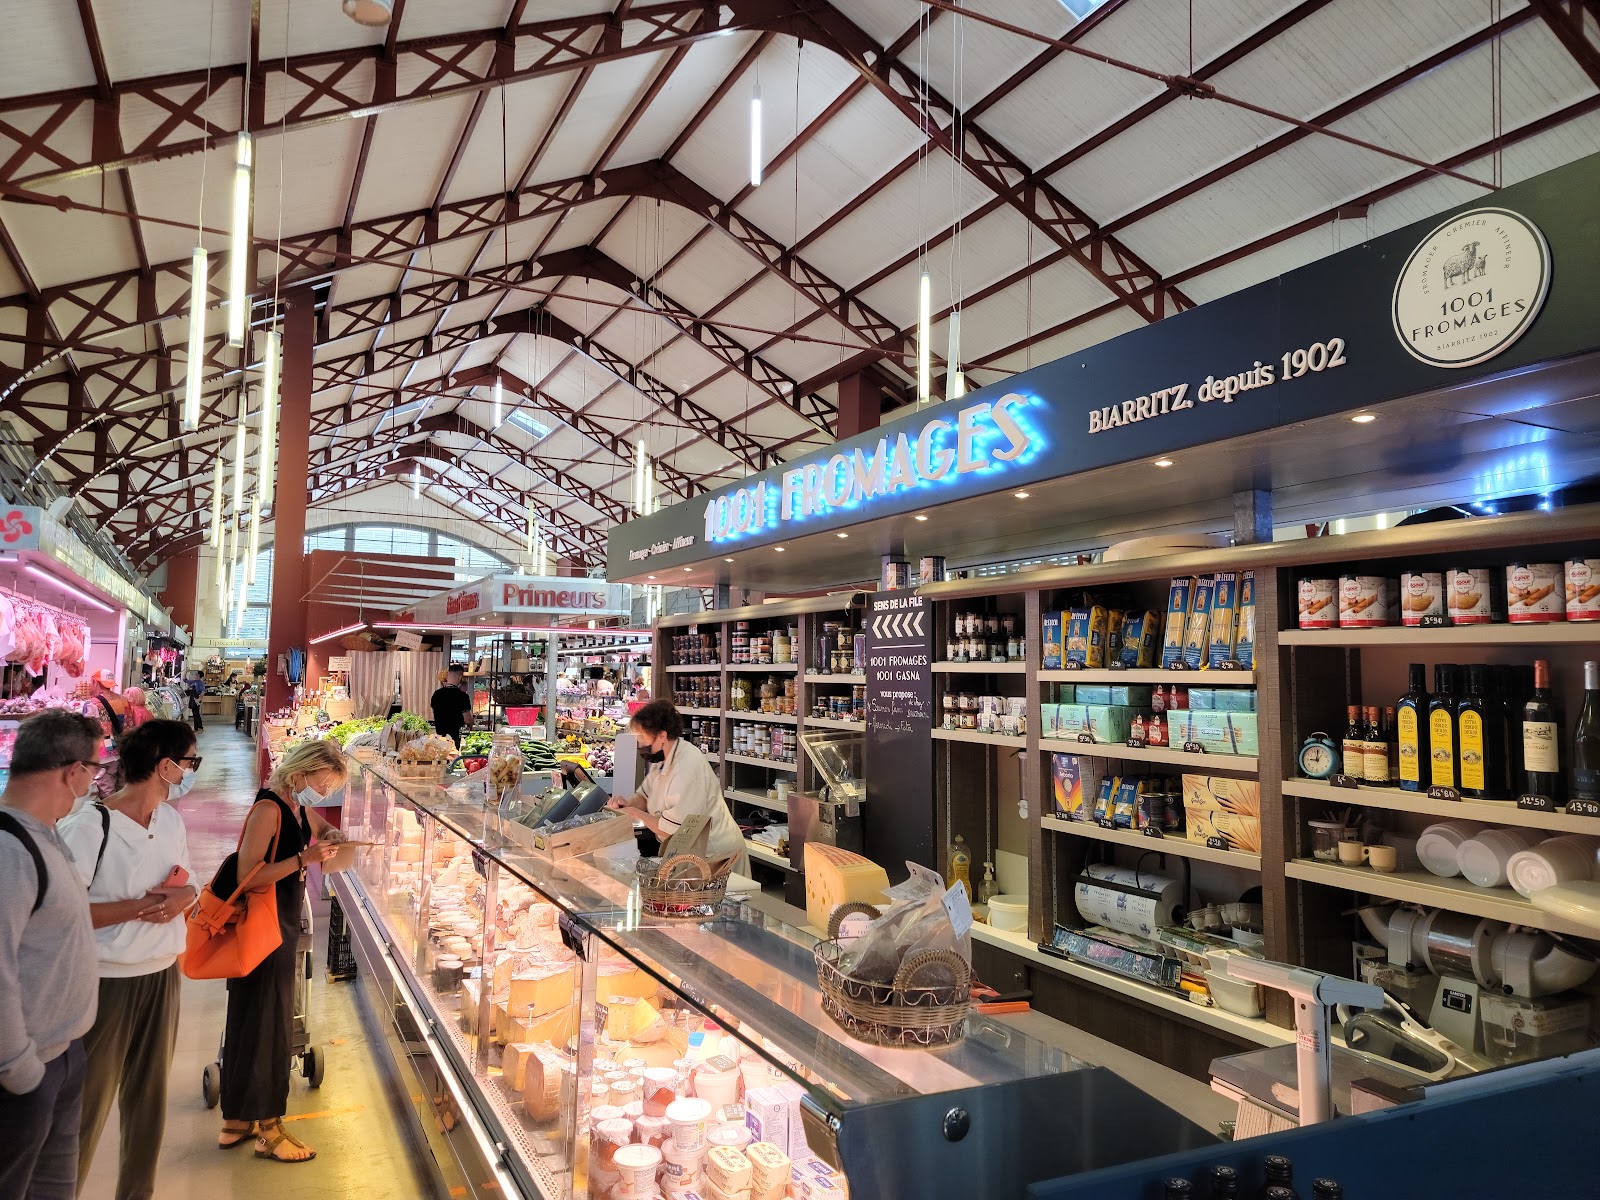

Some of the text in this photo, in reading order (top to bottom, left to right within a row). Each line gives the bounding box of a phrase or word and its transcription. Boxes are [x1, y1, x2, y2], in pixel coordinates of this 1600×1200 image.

[1421, 244, 1439, 295] FROMAGER
[1494, 226, 1513, 270] AFFINEUR
[1440, 287, 1494, 317] 1001
[1412, 298, 1526, 342] FROMAGES
[1437, 330, 1499, 351] BIARRITZ 1902
[1197, 361, 1276, 404] depuis
[1281, 337, 1347, 380] 1902
[703, 392, 1031, 542] 1001 FROMAGES
[503, 583, 607, 609] Primeurs
[873, 596, 923, 611] SENS DE LA FILE
[870, 655, 927, 667] 1001 FROMAGES
[876, 670, 920, 681] 1001 GASNA
[879, 690, 892, 698] vous
[1449, 990, 1466, 999] SANTOS
